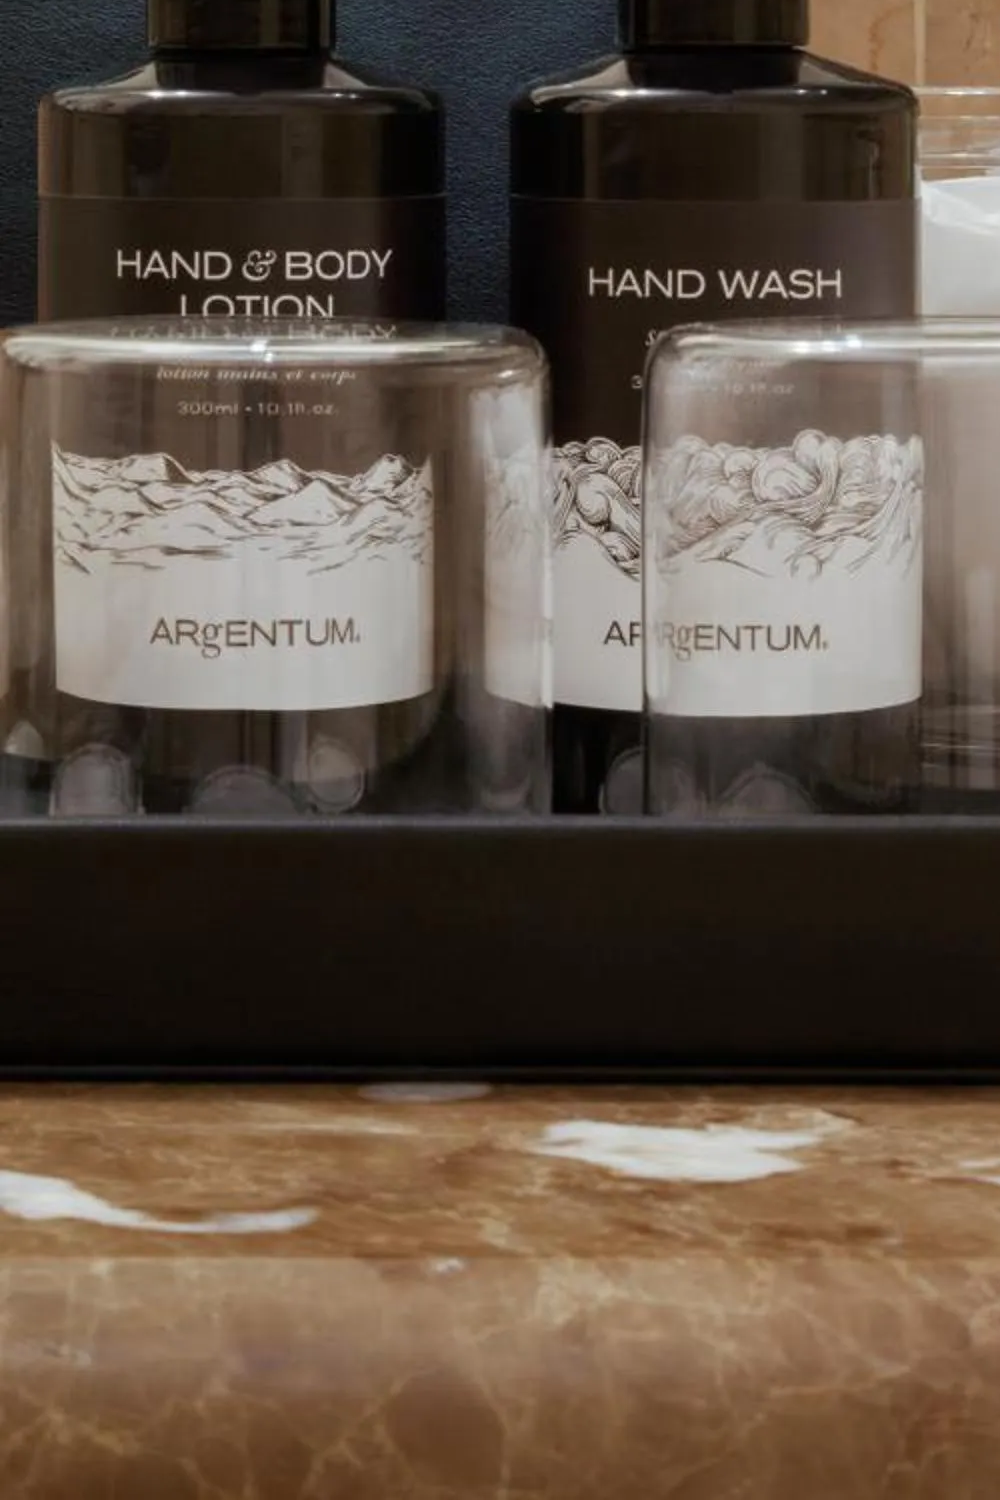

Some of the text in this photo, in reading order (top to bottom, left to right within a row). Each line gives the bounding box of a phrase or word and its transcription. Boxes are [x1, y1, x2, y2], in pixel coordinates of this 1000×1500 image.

[116, 250, 393, 281] HAND & BODY
[588, 268, 842, 299] HAND WASH
[181, 295, 334, 318] LOTION
[178, 401, 239, 416] 300ml
